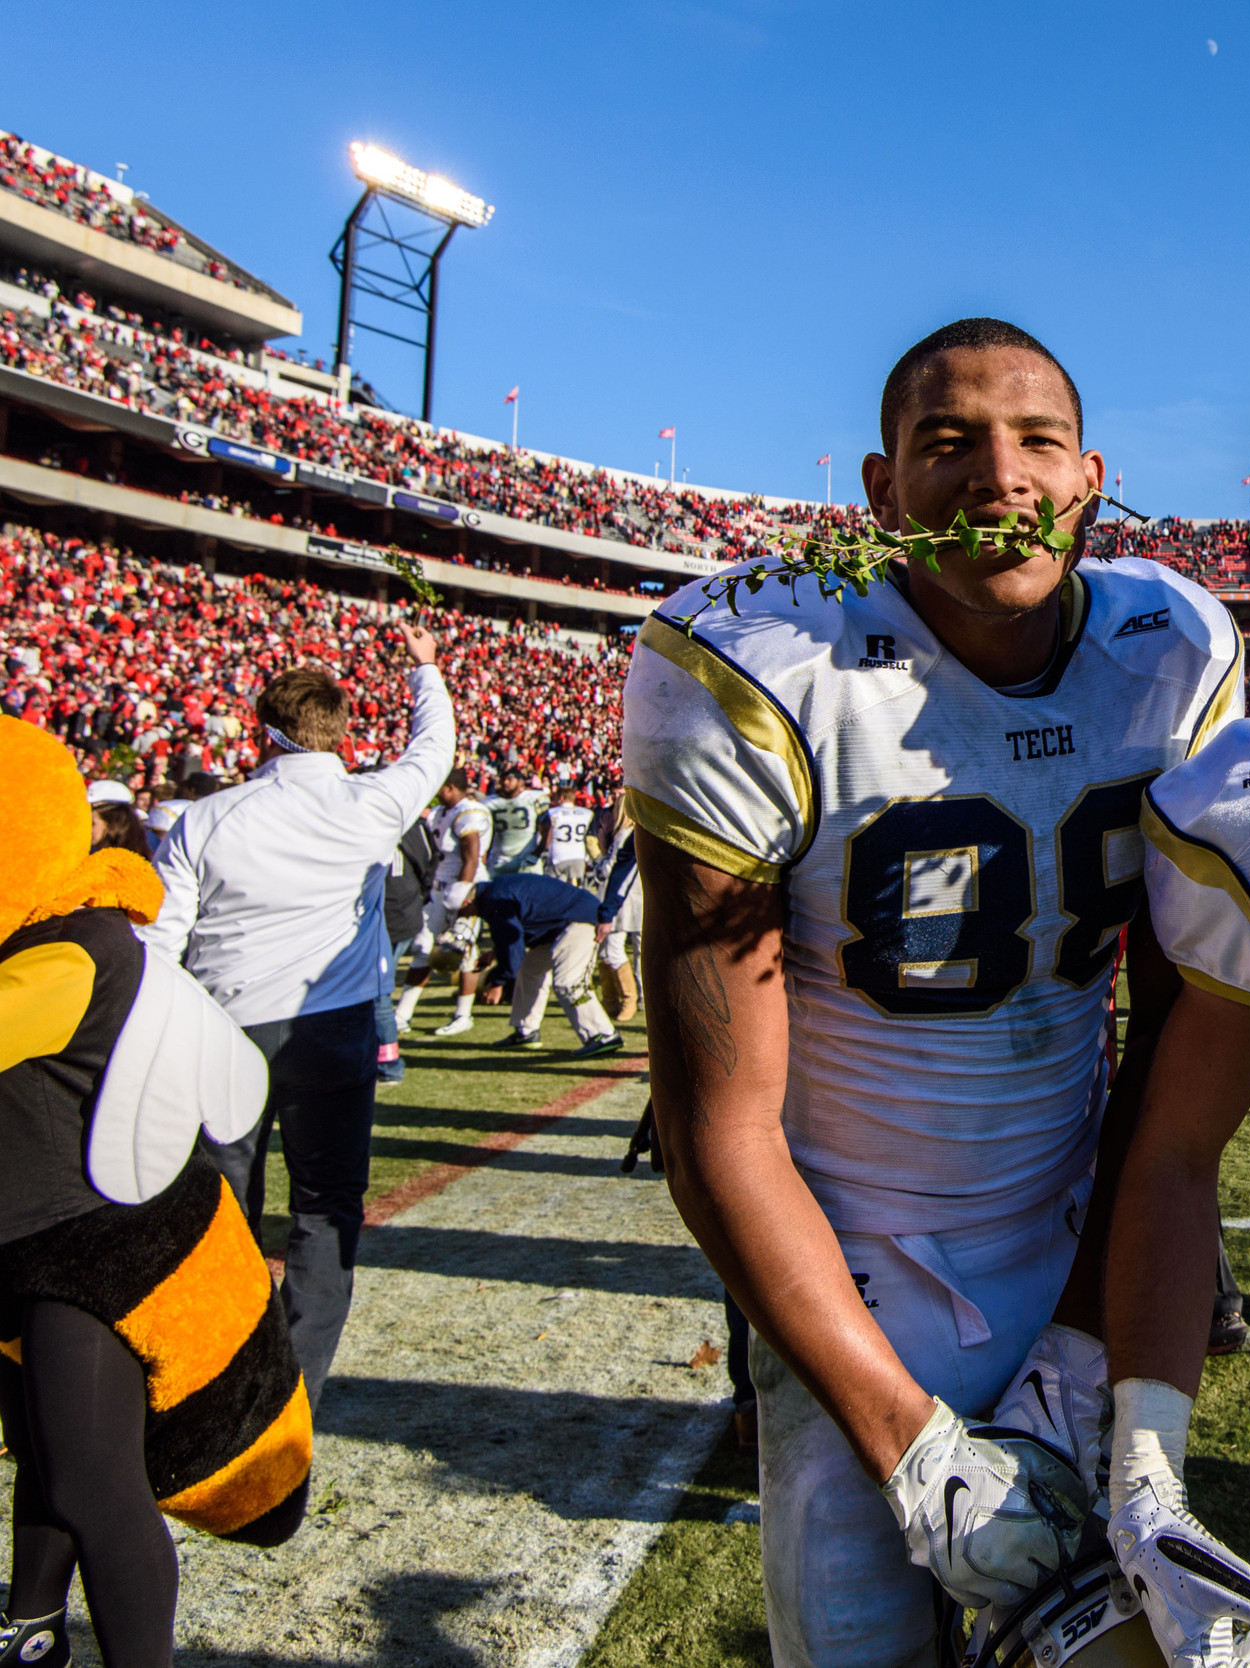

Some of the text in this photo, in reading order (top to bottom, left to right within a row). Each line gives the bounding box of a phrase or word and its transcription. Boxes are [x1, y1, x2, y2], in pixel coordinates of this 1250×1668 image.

[683, 561, 718, 573] NORTH
[1115, 607, 1170, 634] ACC
[866, 634, 896, 660] R
[858, 657, 909, 671] RUSSELL
[1005, 724, 1076, 761] TECH
[493, 806, 530, 832] 53
[556, 823, 587, 842] 39
[1062, 1600, 1109, 1650] ACC
